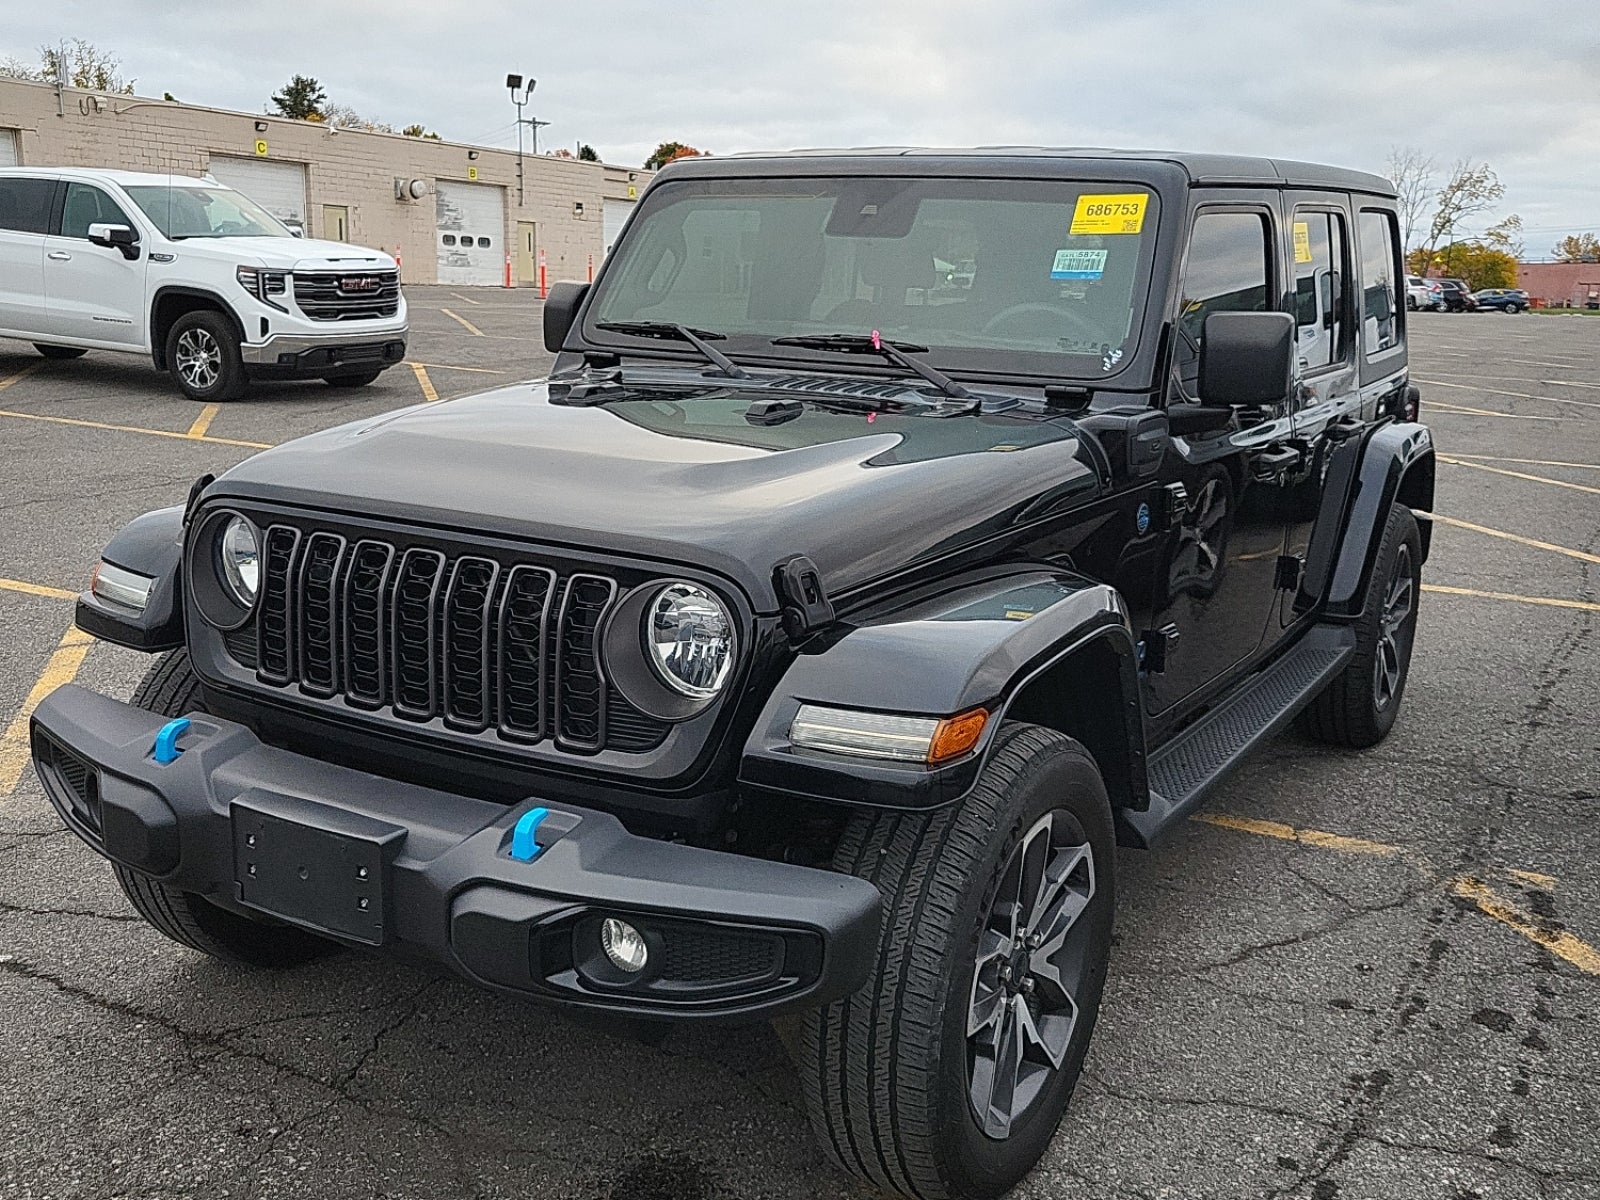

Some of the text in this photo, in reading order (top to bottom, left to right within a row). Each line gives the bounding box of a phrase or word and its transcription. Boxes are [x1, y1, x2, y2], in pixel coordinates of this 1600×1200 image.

[257, 142, 266, 153] C
[469, 168, 476, 178] B
[1086, 203, 1139, 216] 686753
